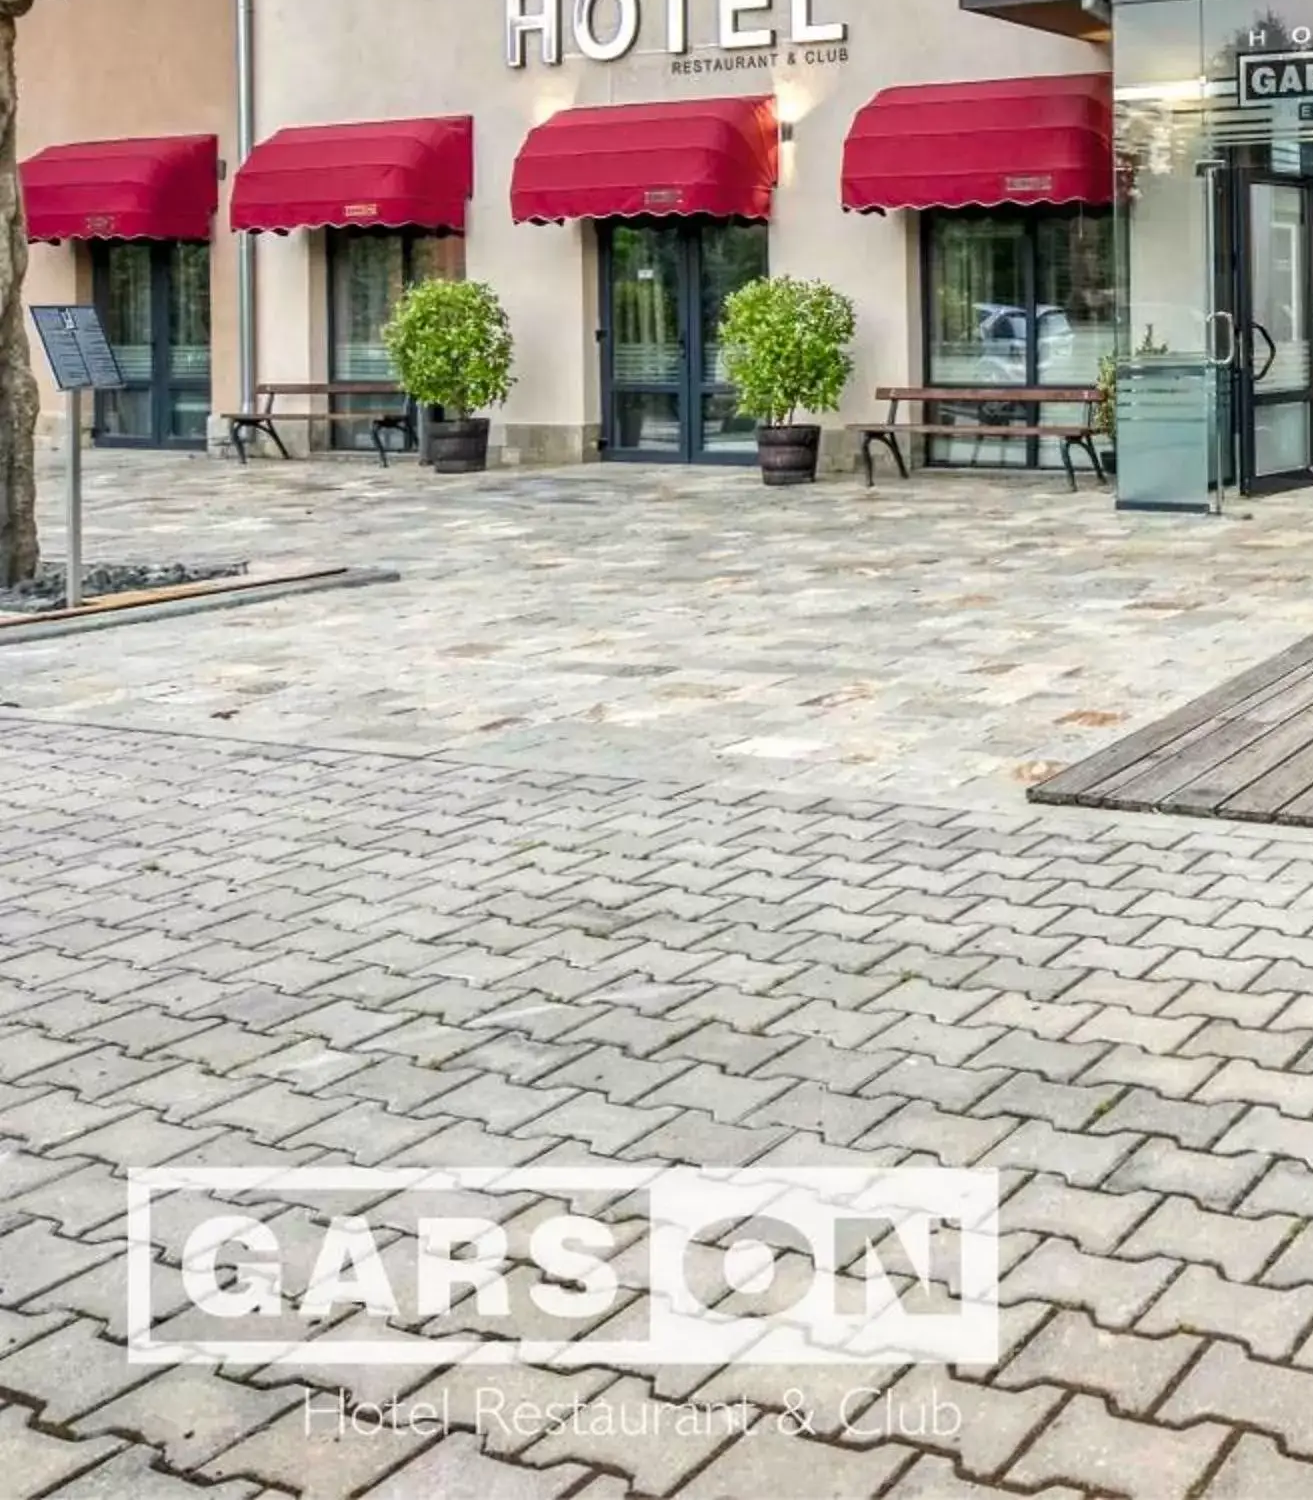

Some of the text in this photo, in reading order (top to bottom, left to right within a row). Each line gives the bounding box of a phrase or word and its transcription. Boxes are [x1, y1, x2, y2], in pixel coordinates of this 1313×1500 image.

[671, 47, 849, 76] RESTAURANT & CLUB
